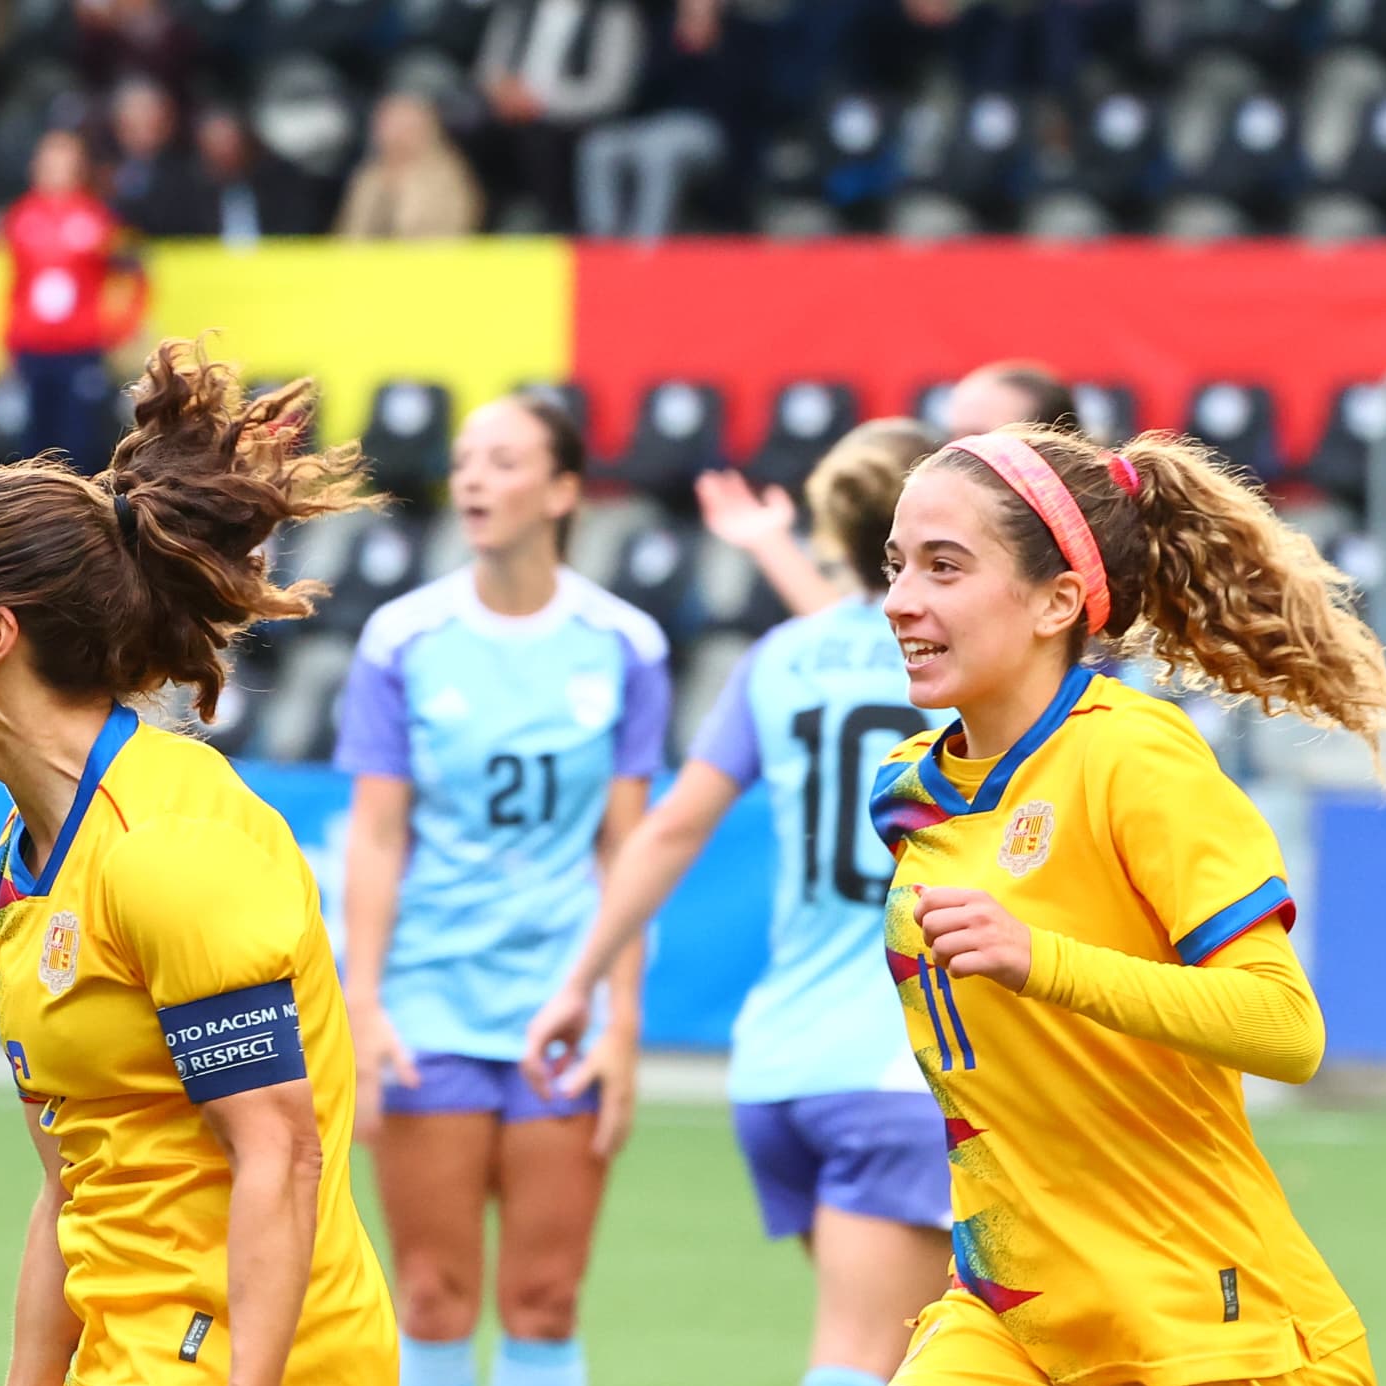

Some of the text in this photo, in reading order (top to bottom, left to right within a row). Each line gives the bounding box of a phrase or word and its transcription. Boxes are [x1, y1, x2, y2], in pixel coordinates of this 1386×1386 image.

[485, 754, 559, 828] 21
[791, 703, 929, 907] 10
[177, 1026, 203, 1043] TO
[205, 1007, 278, 1036] RACISM
[917, 953, 976, 1071] 11
[190, 1037, 275, 1072] RESPECT
